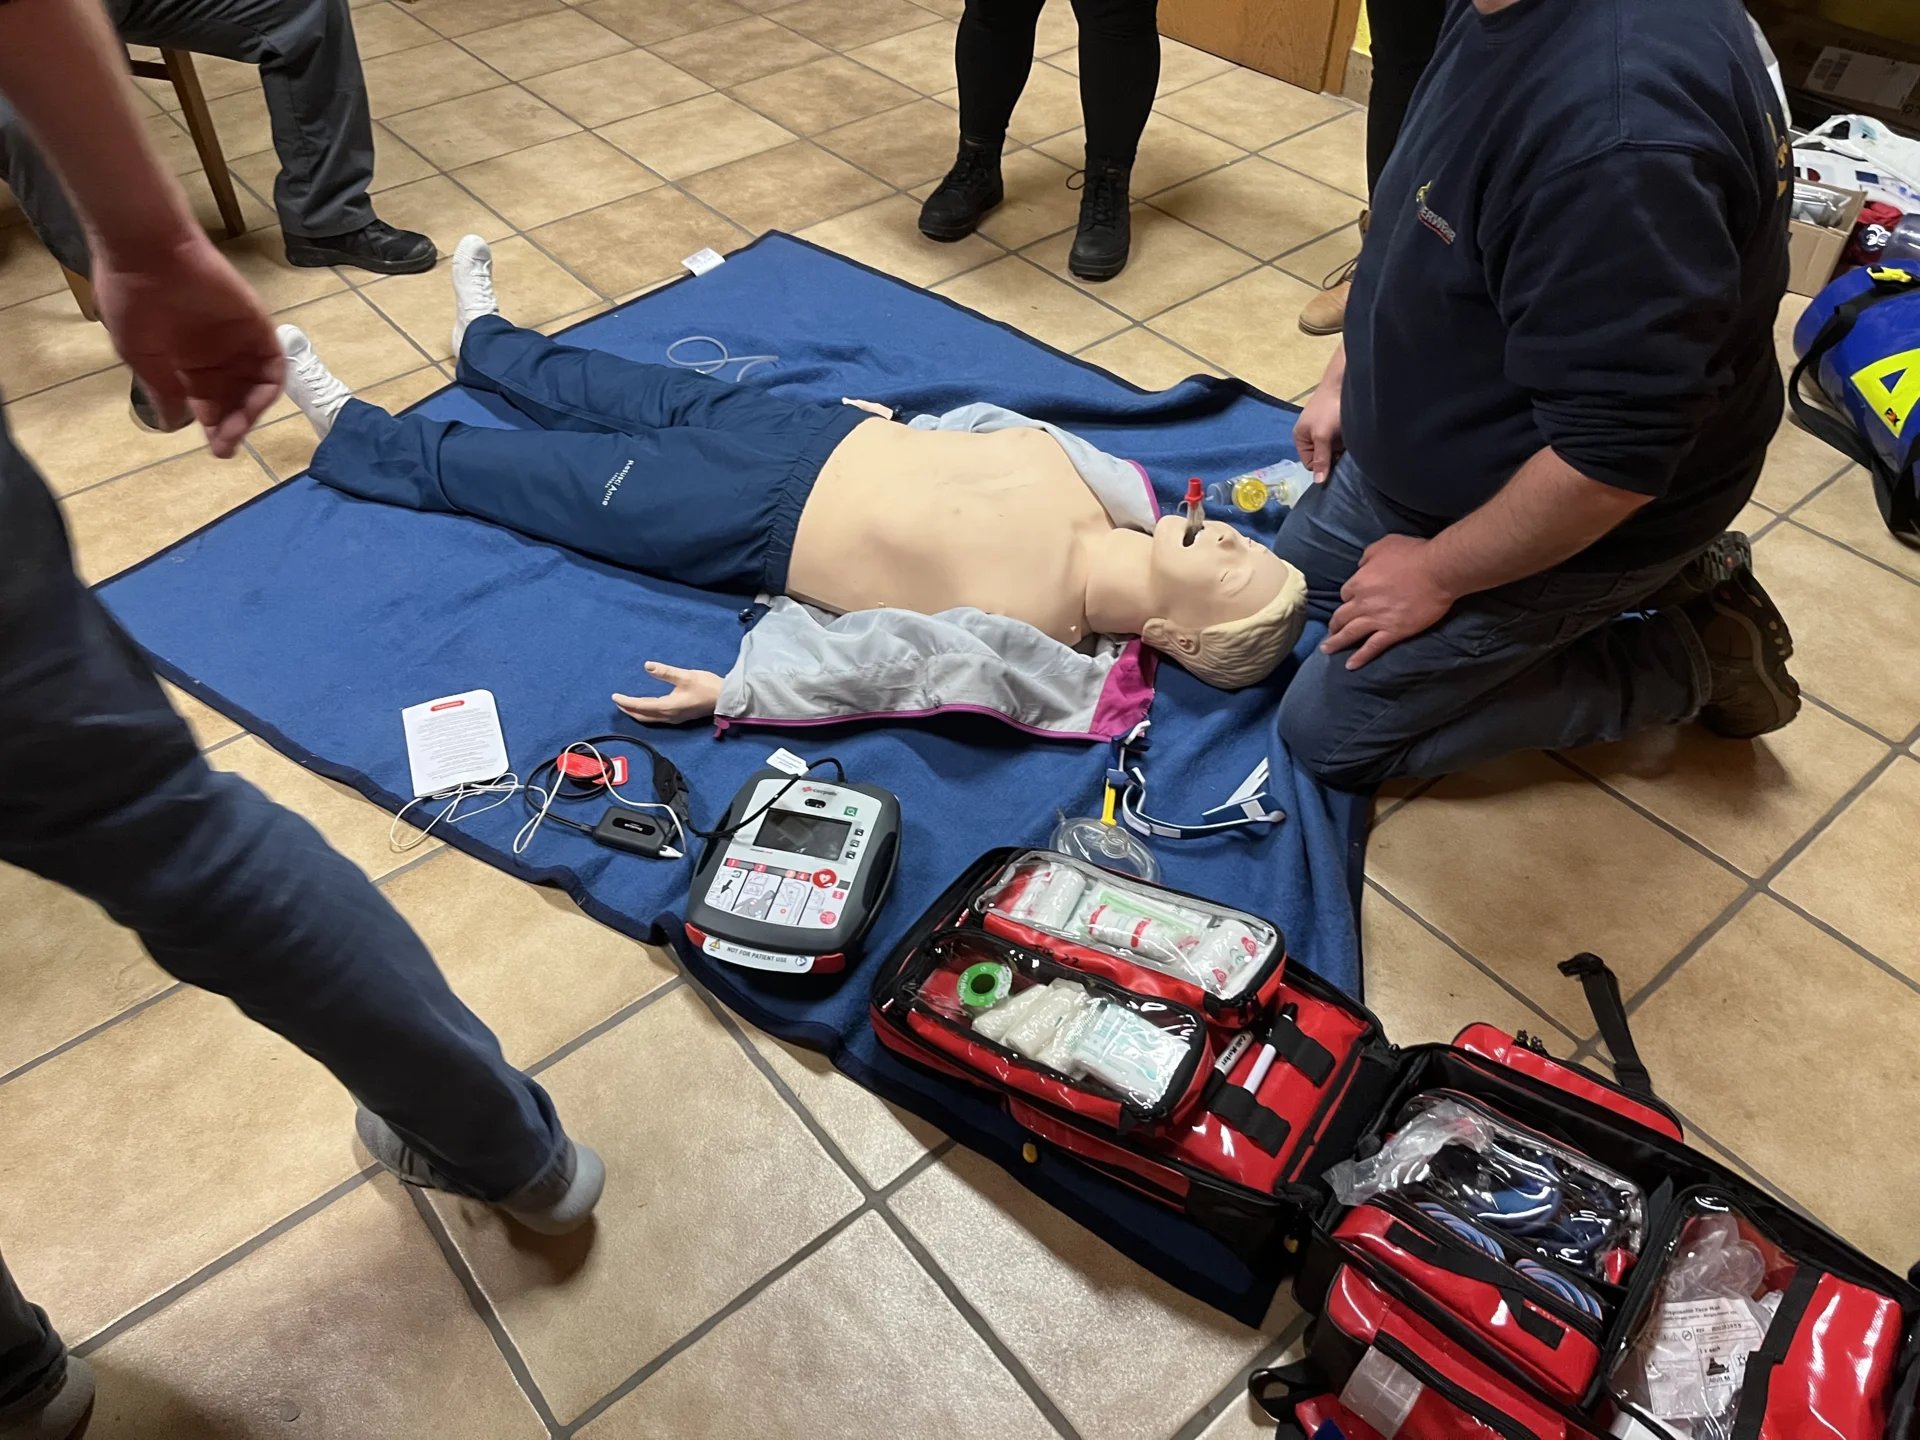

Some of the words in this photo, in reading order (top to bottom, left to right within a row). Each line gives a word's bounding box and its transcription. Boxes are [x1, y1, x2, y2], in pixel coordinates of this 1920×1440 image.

[727, 946, 739, 954] NOT
[738, 949, 751, 957] FOR
[751, 952, 775, 962] PATIENT
